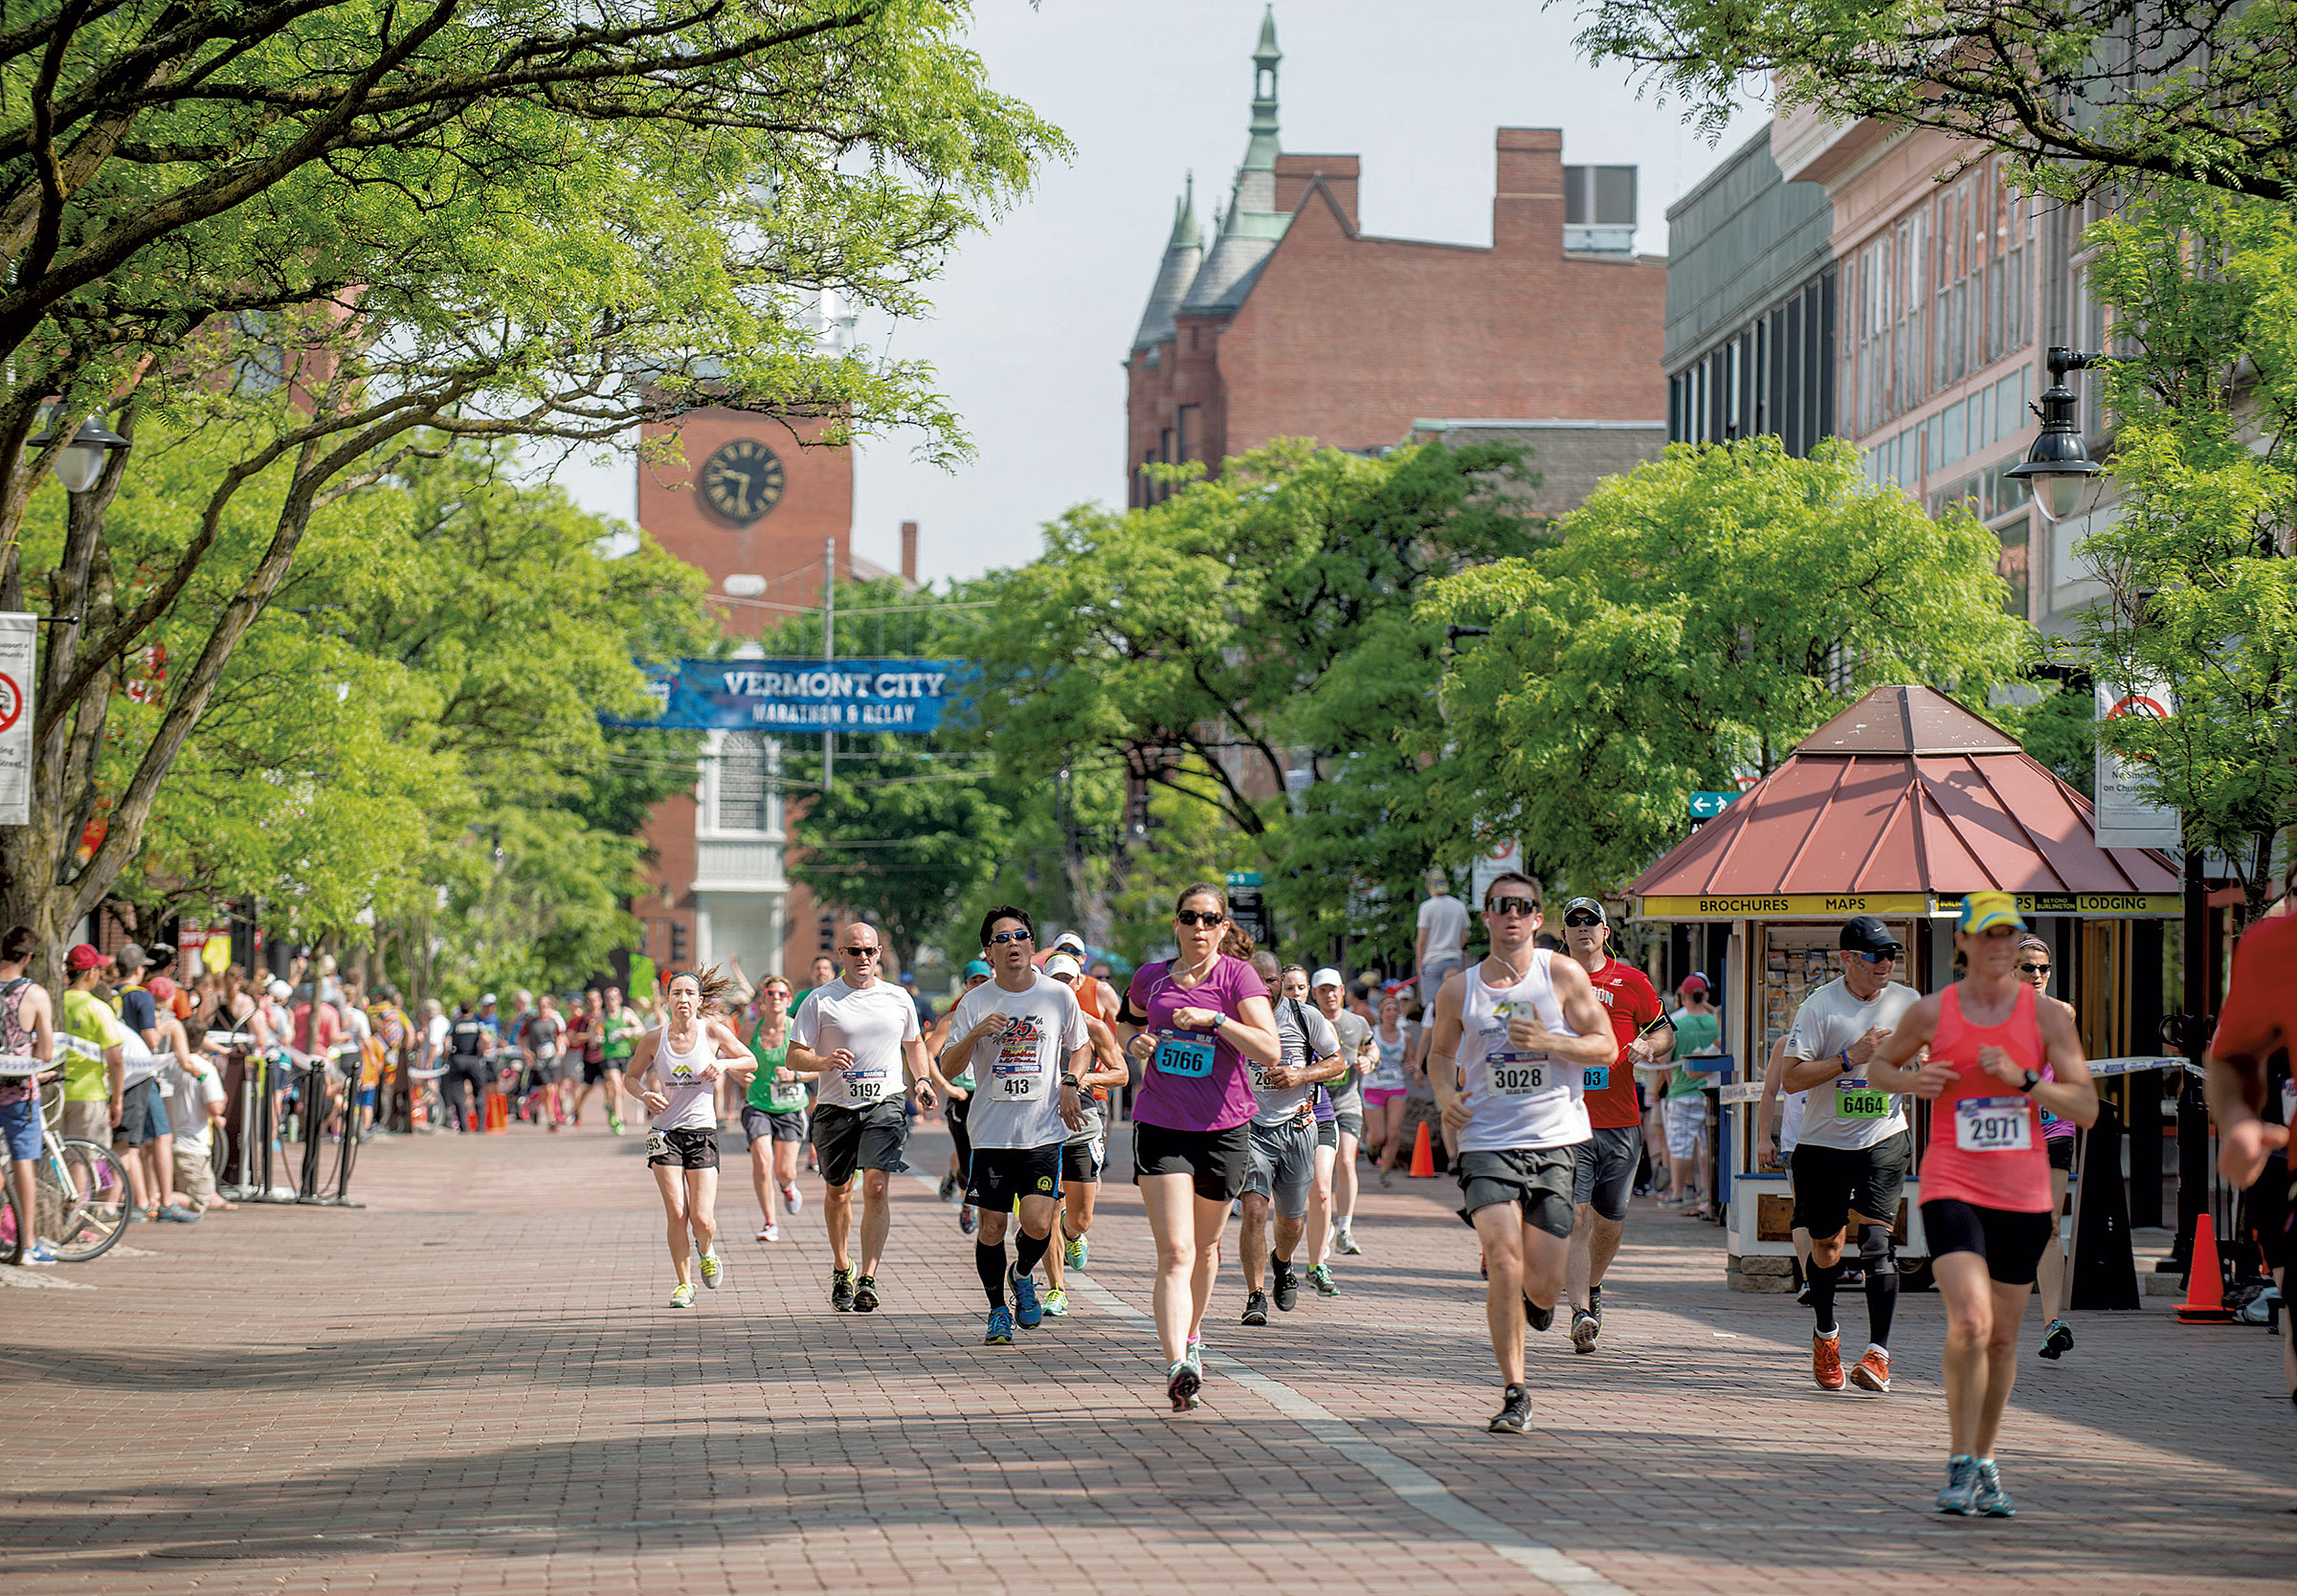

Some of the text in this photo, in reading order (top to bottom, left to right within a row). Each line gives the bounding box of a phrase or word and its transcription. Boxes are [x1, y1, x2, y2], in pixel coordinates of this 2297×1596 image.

[723, 672, 947, 698] VERMONT CITY
[752, 704, 841, 723] MARATHON
[863, 704, 916, 723] RELAY
[1700, 898, 1865, 912] BROCHURES MAPS
[2080, 897, 2147, 910] LODGING
[1162, 1048, 1203, 1072] 5766
[1004, 1079, 1029, 1095] 413
[1495, 1069, 1542, 1088] 3028
[850, 1083, 881, 1097] 3192
[1844, 1097, 1883, 1114] 6464
[1970, 1117, 2018, 1141] 2971
